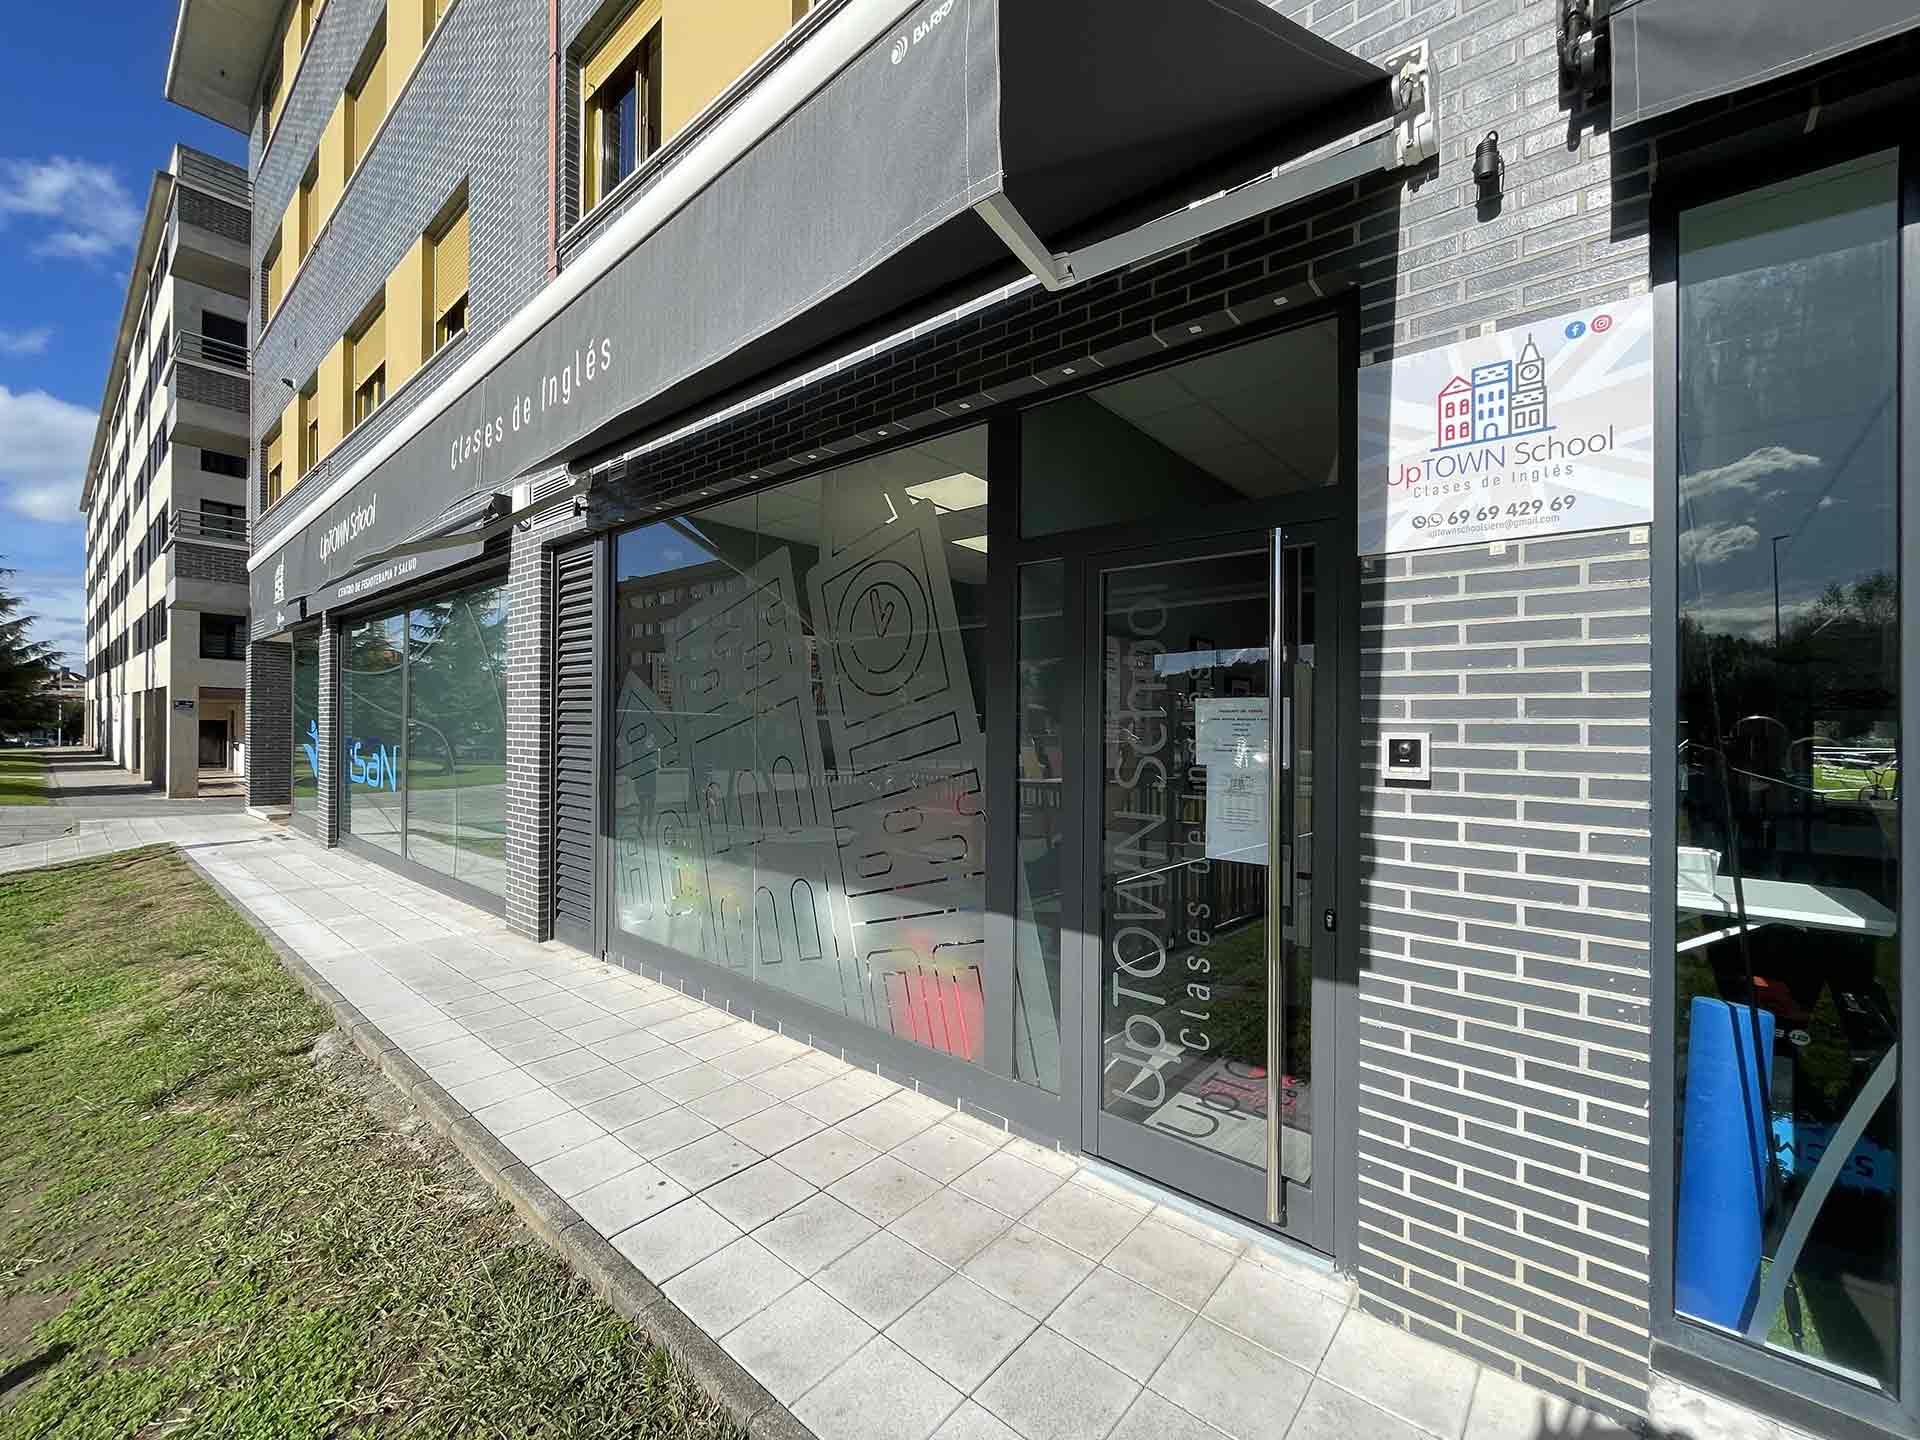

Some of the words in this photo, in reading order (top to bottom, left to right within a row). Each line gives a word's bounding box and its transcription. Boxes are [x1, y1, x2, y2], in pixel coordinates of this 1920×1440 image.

[450, 415, 503, 470] Clases
[511, 395, 531, 432] de
[541, 338, 612, 411] Inglés
[1386, 446, 1505, 488] UpTOWN
[1513, 424, 1614, 465] School
[1413, 480, 1471, 498] Clases
[1481, 475, 1501, 489] de
[1511, 464, 1573, 484] Inglés
[320, 517, 350, 565] UpTOWN
[350, 493, 377, 540] School
[1447, 509, 1470, 525] 69
[1476, 505, 1500, 521] 69
[1506, 499, 1543, 517] 429
[1550, 494, 1577, 511] 69
[1112, 811, 1182, 1109] UpTOWN
[1179, 902, 1211, 1051] Clases
